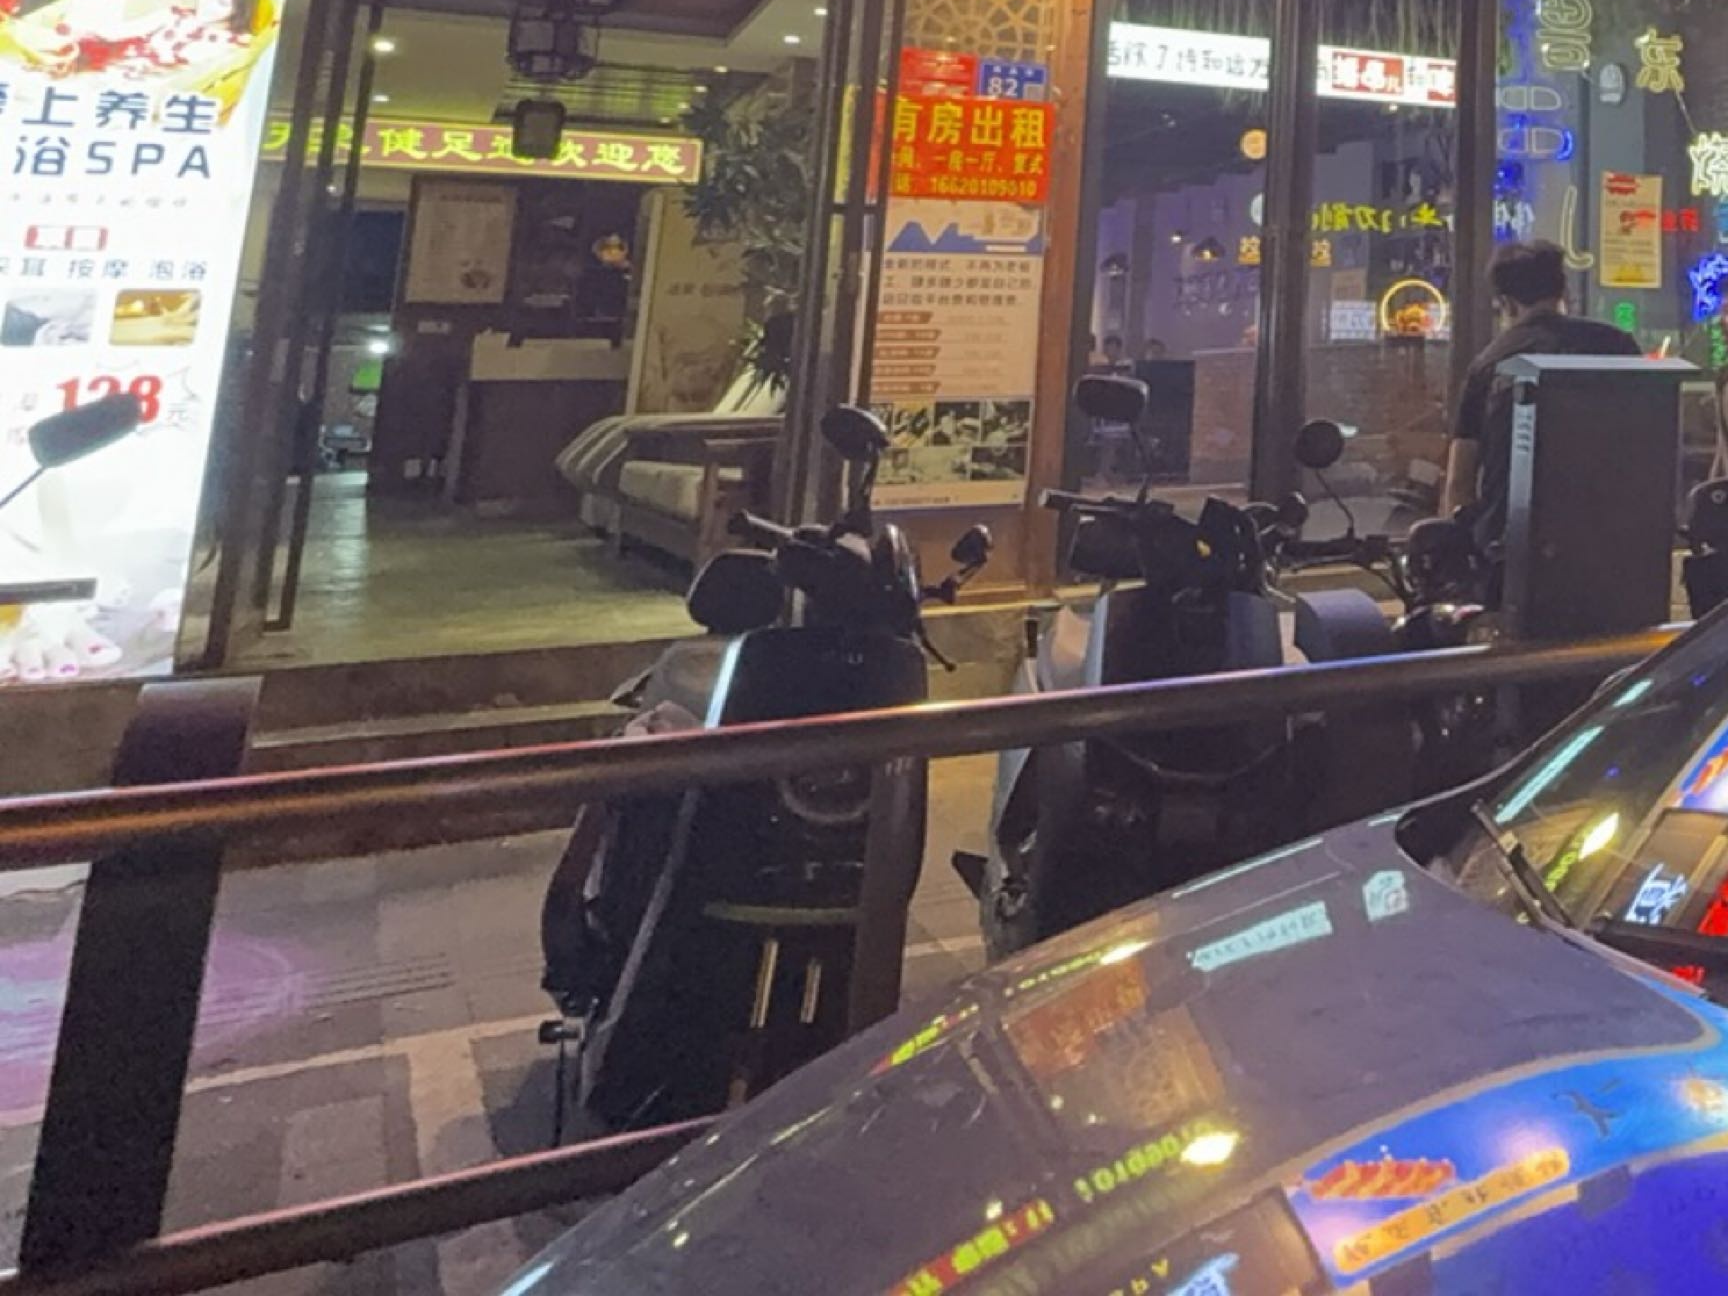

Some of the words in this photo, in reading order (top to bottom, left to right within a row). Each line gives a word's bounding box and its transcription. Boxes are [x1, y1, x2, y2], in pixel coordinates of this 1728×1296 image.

[0, 84, 217, 134] 上养生
[987, 78, 1019, 98] 82
[893, 95, 1046, 149] 有房出租
[13, 135, 211, 179] 浴SPA
